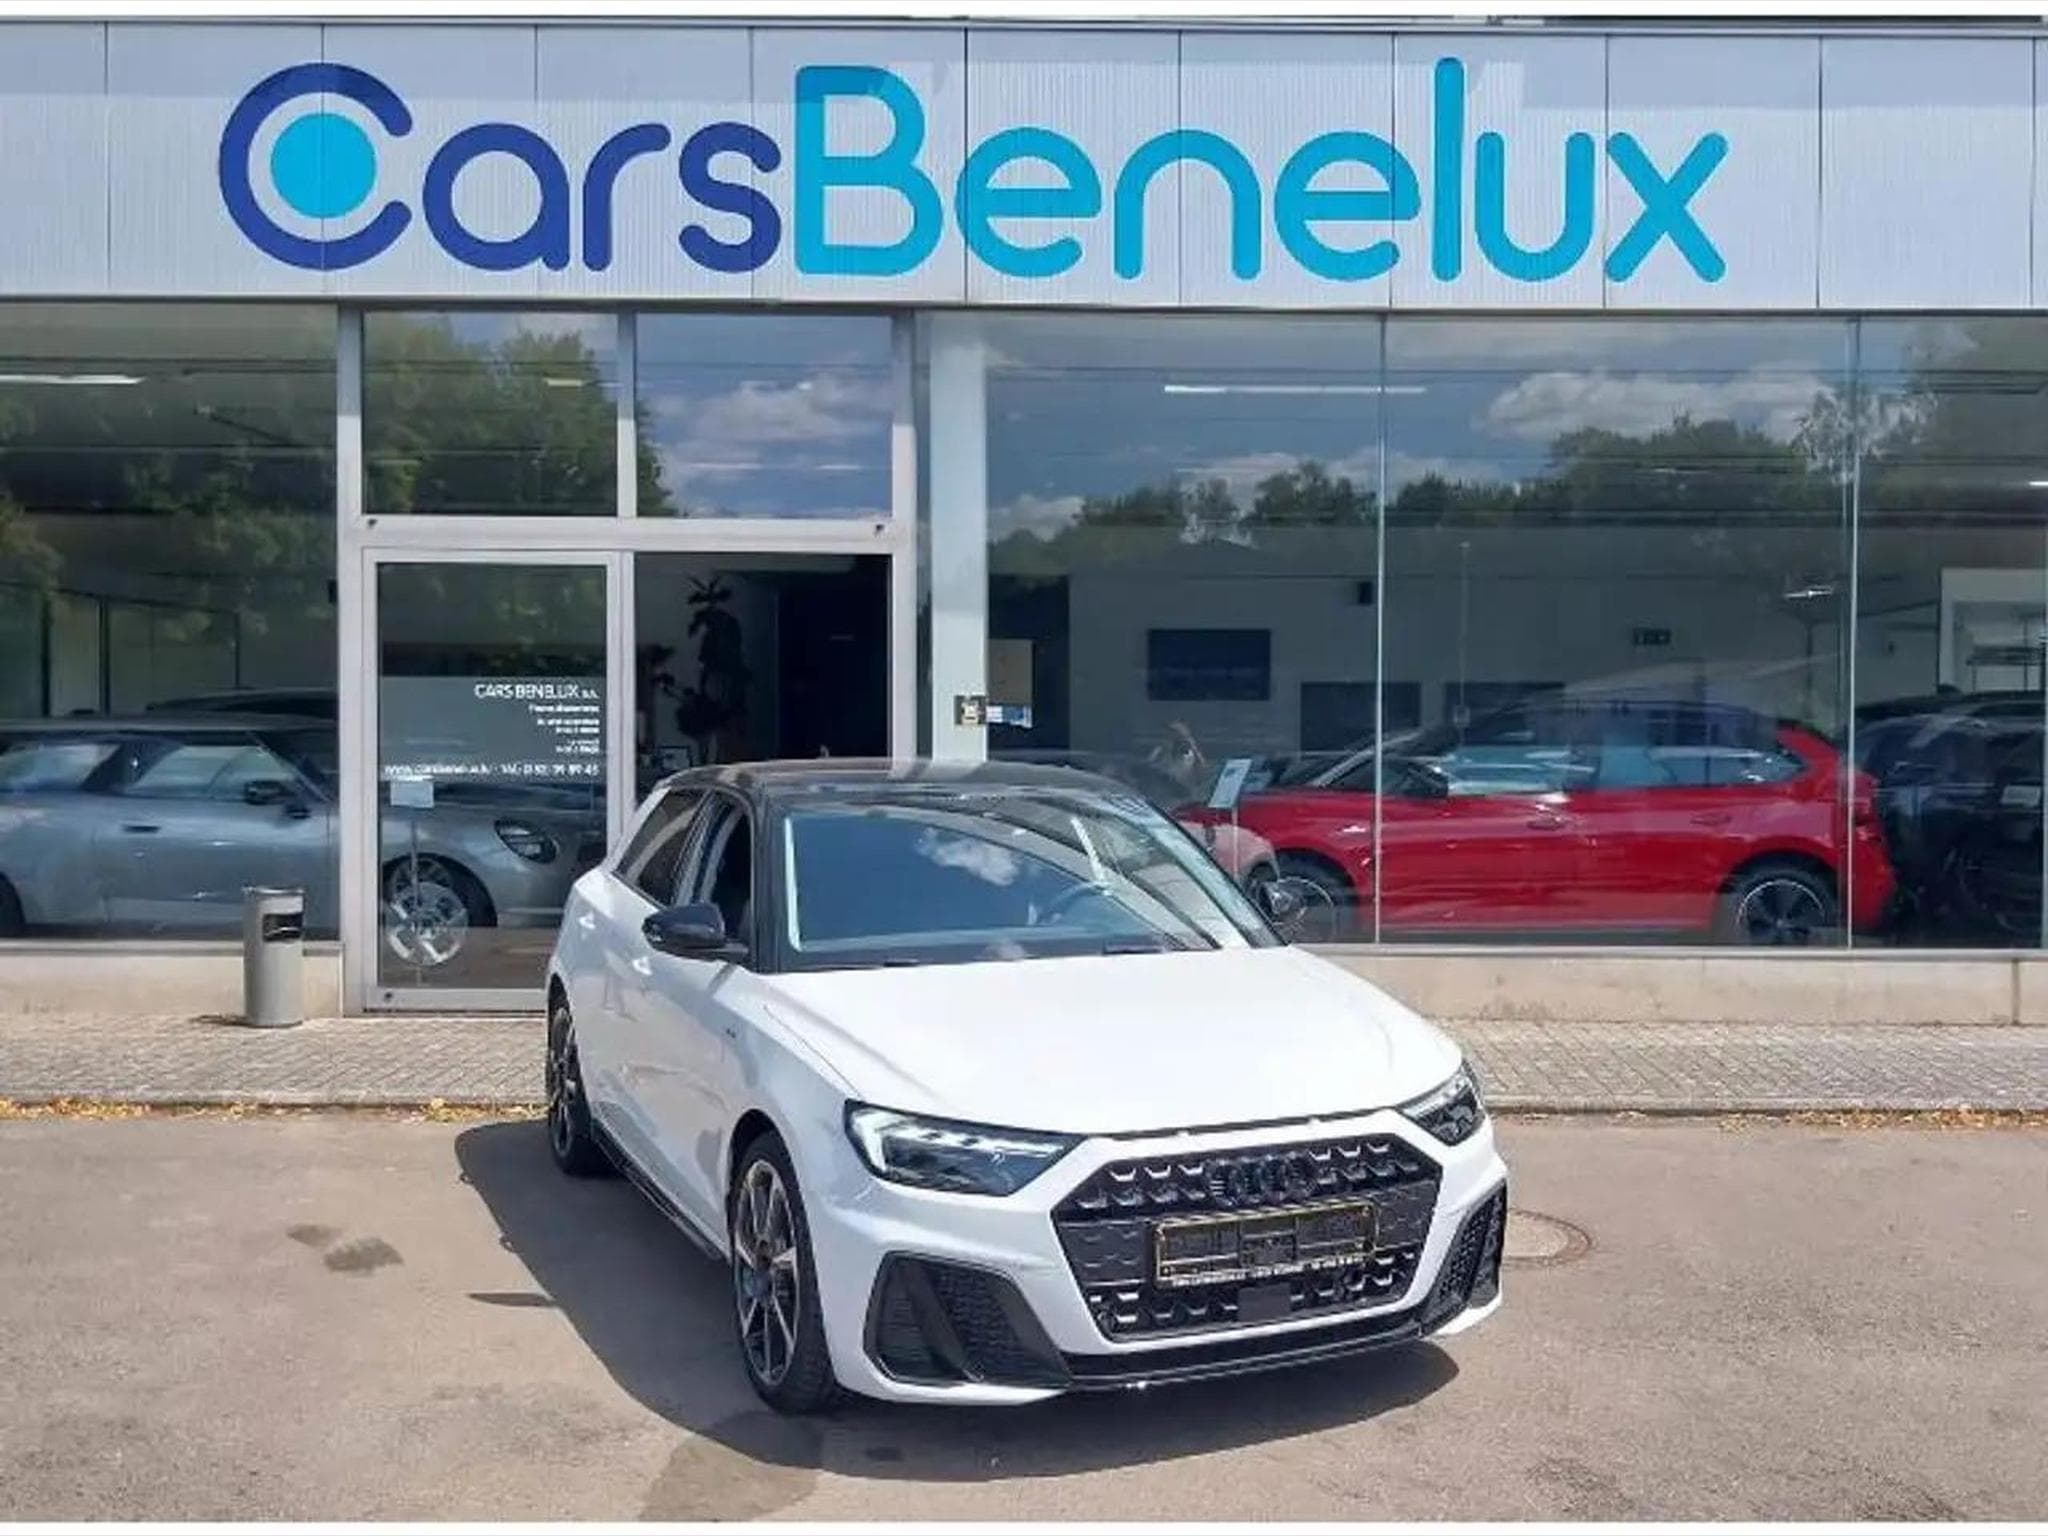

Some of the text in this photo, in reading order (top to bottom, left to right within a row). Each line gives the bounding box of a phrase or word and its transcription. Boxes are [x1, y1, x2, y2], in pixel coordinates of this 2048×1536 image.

[219, 57, 1729, 283] CarsBenelux
[474, 683, 514, 699] CARS
[515, 683, 580, 699] BENELUX
